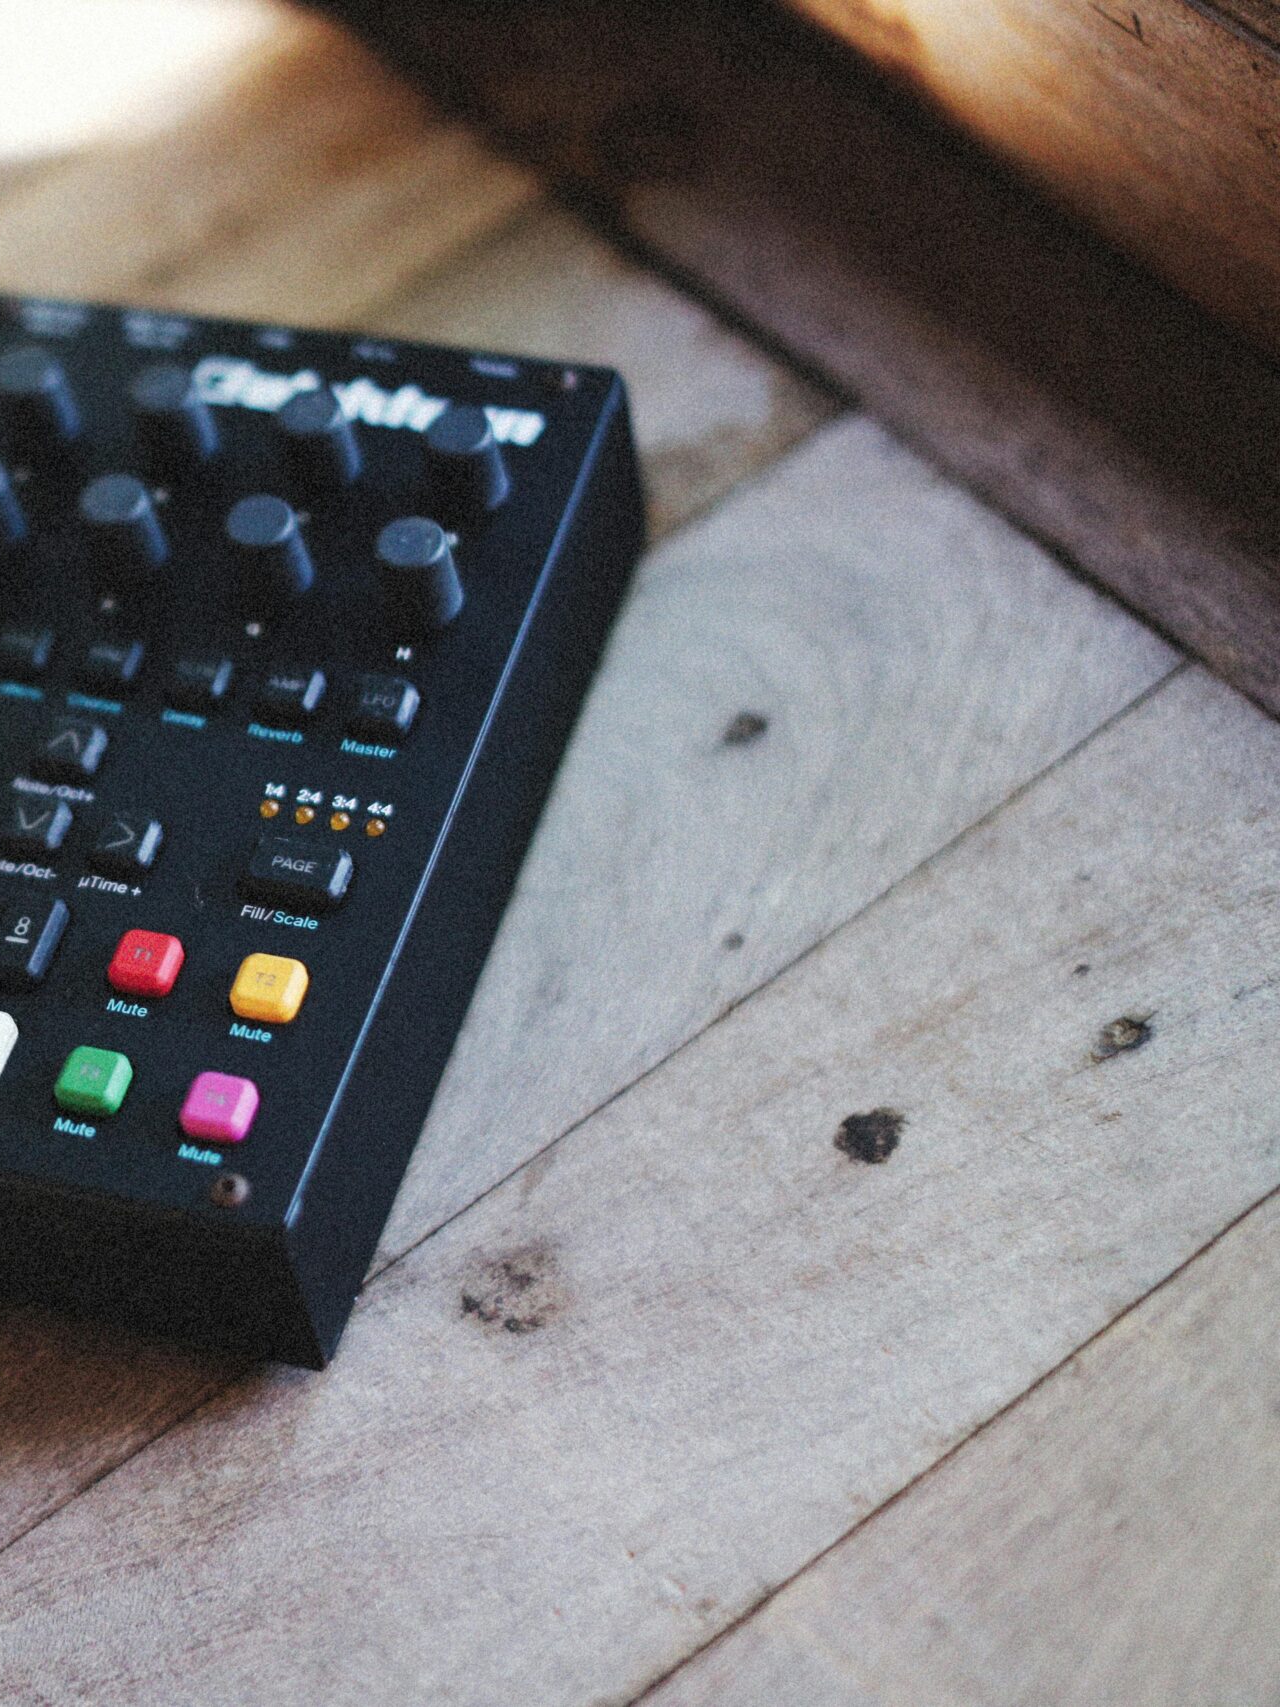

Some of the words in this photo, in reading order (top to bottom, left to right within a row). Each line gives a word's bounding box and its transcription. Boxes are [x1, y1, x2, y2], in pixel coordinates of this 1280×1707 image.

[247, 722, 304, 744] Reverb
[340, 738, 397, 759] Master
[271, 855, 317, 874] PAGE
[13, 916, 32, 936] 8
[240, 904, 319, 930] Fill/Scale
[133, 947, 153, 962] T1
[255, 972, 276, 986] T2
[106, 998, 148, 1018] Mute
[229, 1022, 272, 1043] Mute
[53, 1117, 97, 1138] Mute
[177, 1143, 222, 1165] Mute
